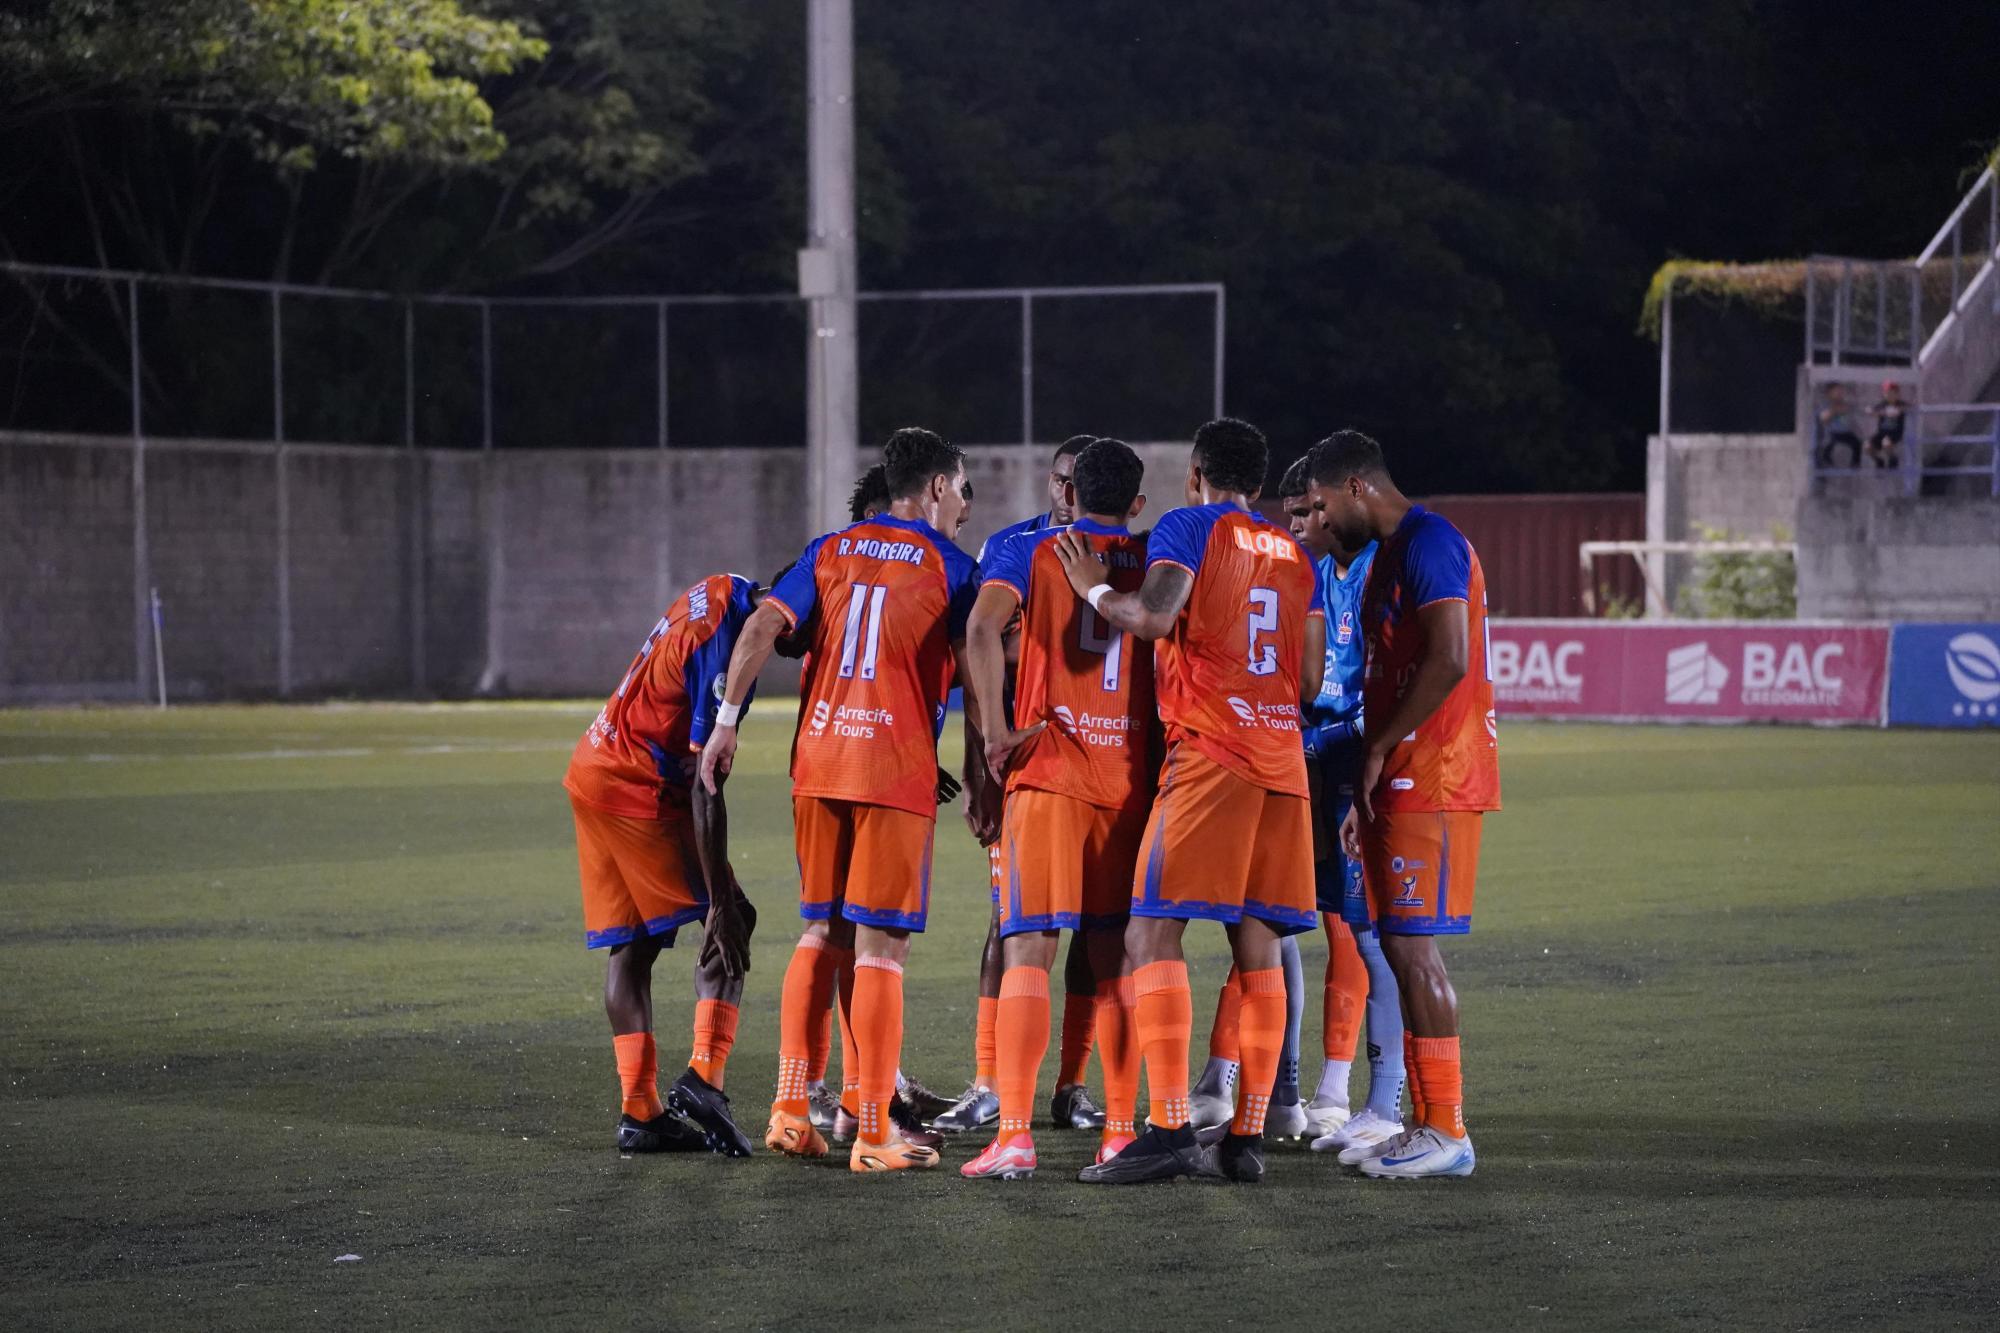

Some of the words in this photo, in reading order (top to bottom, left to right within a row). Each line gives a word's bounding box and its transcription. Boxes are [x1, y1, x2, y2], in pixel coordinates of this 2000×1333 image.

[838, 537, 925, 567] R.MOREIRA
[838, 582, 887, 680] 11
[1248, 586, 1279, 675] 2
[1492, 640, 1585, 687] BAC
[1743, 641, 1844, 689] BAC
[833, 704, 894, 726] Arrecife
[833, 721, 875, 739] Tours
[1079, 712, 1141, 731] Arrecife
[1079, 728, 1123, 747] Tours
